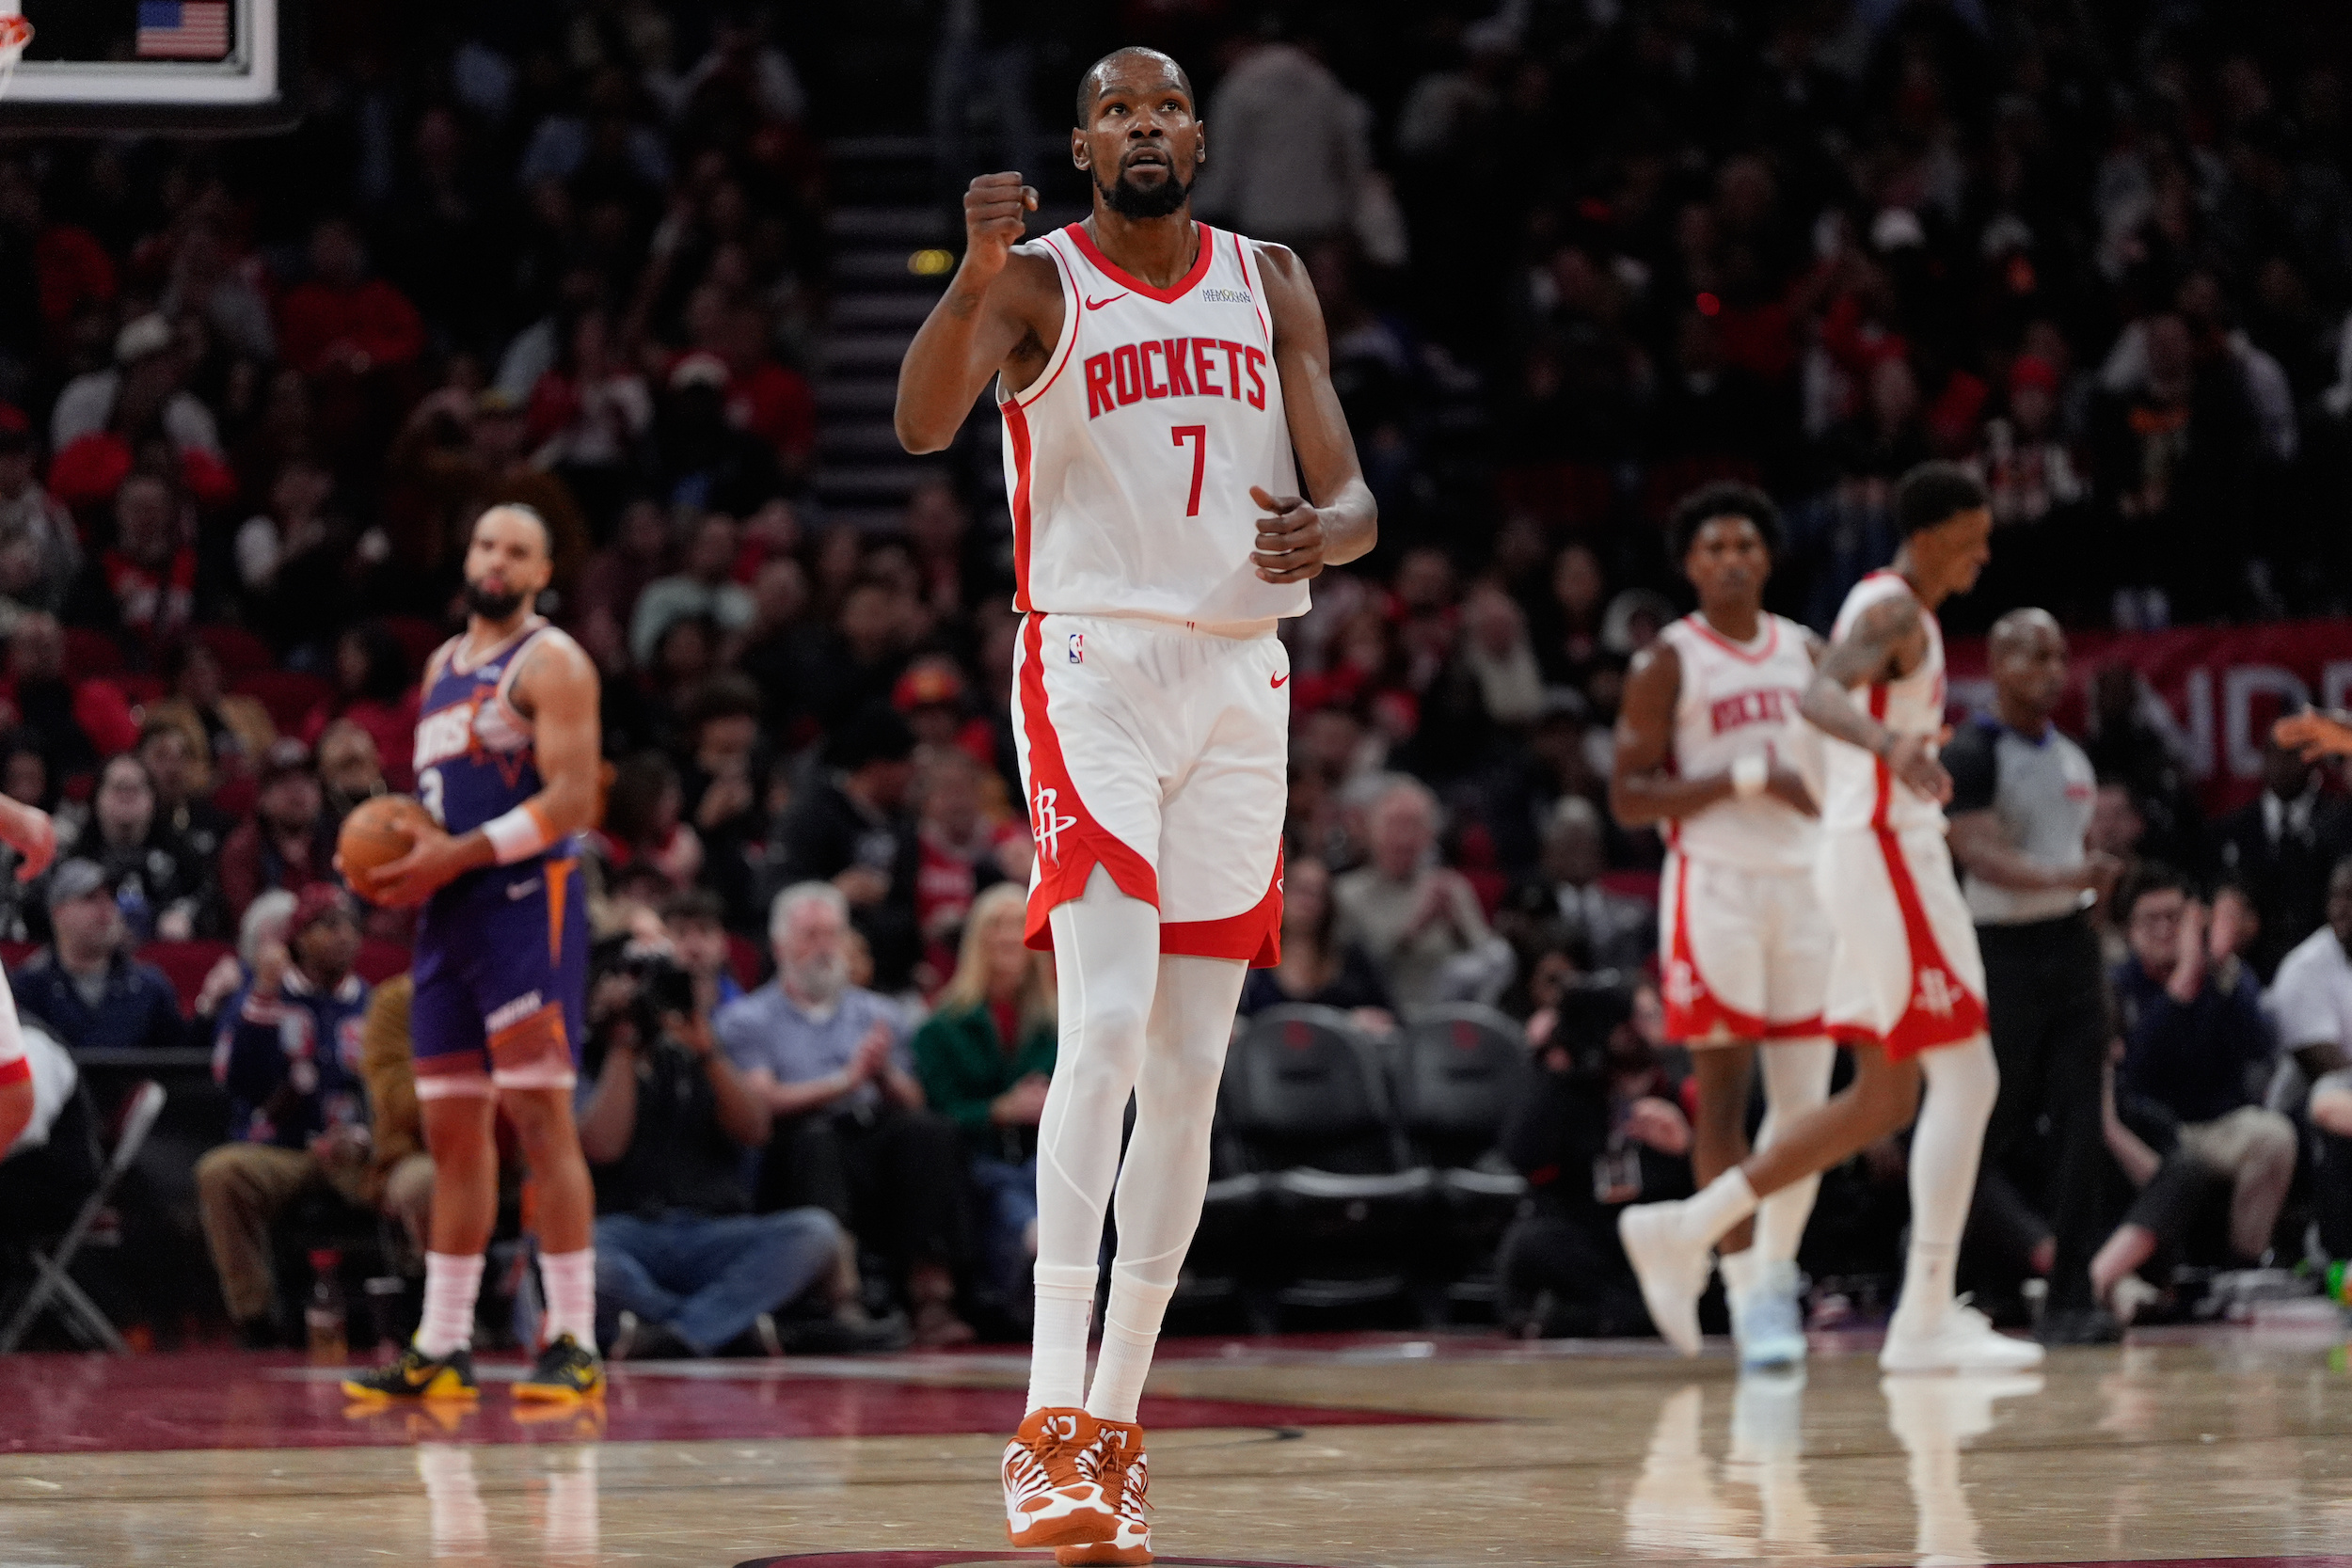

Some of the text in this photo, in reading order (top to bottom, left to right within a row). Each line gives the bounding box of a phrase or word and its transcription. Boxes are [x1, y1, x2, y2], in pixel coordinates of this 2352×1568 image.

[1202, 289, 1249, 298] MEMORIAL
[1203, 294, 1251, 303] HERMANN
[1084, 337, 1266, 421] ROCKETS
[1171, 424, 1206, 516] 7
